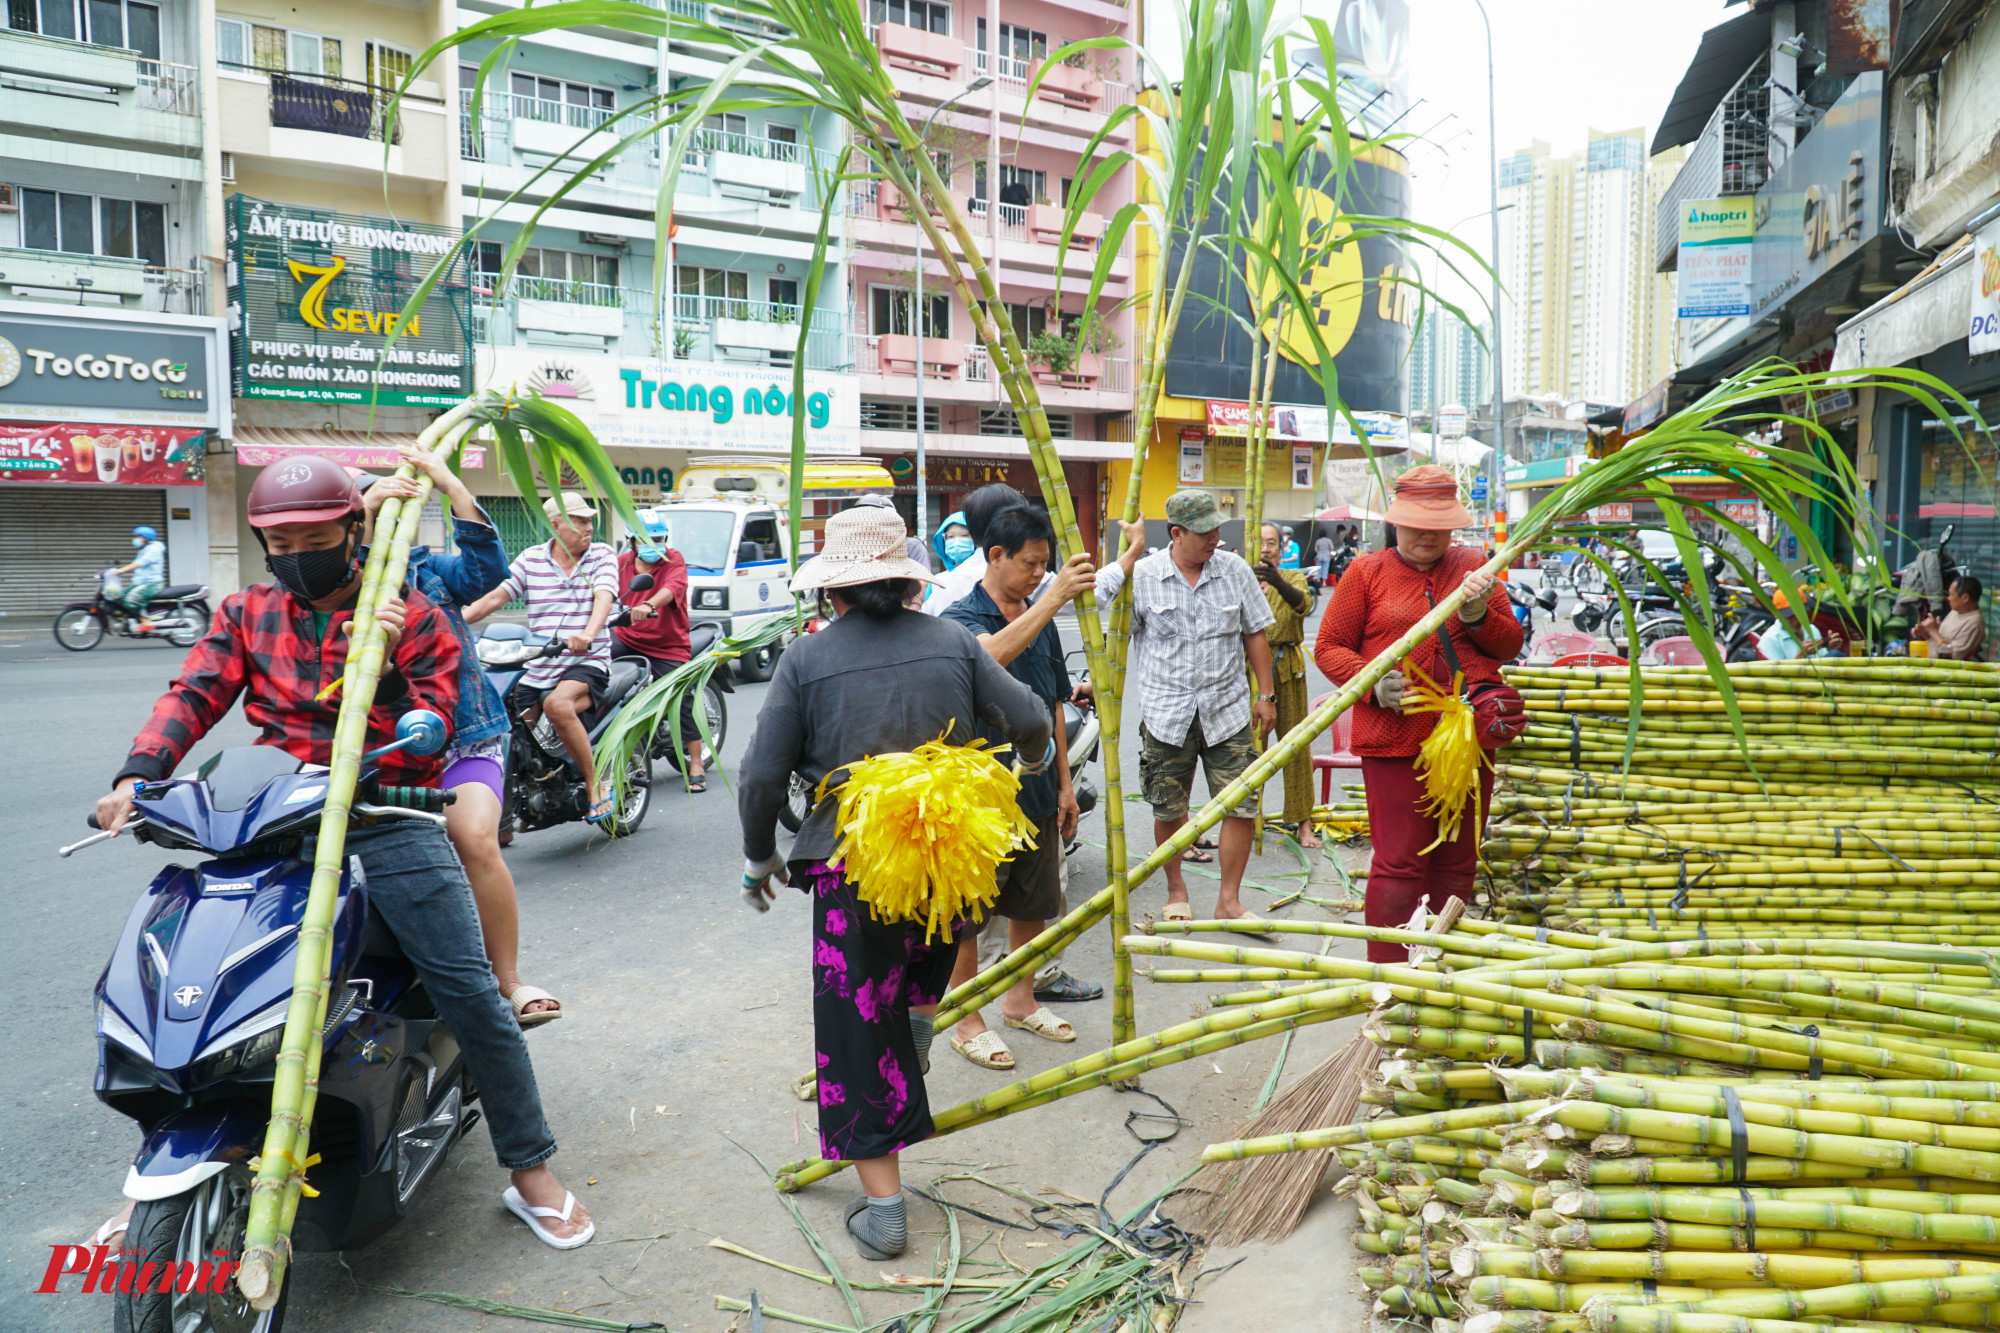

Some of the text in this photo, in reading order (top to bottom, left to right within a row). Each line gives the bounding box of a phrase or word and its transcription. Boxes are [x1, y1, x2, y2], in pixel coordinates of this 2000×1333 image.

[248, 203, 282, 237] ẨM
[286, 217, 346, 248] THỰC
[1701, 209, 1747, 223] hoptri
[1716, 251, 1749, 267] PHÁT
[287, 255, 420, 337] 7 SEVEN
[1971, 313, 1998, 337] ĐC:
[251, 340, 300, 360] PHỤC
[303, 344, 328, 363] VỤ
[331, 340, 375, 362] ĐIỂM
[416, 348, 460, 367] SÁNG
[248, 360, 461, 388] CÁC MÓN XÀO HONGKONG
[545, 368, 575, 381] TKC
[687, 367, 702, 375] TY
[160, 387, 187, 398] Tea
[261, 387, 285, 397] Quang
[335, 391, 361, 400] TPHCM
[619, 367, 734, 424] Trang
[615, 466, 674, 493] ang
[204, 882, 254, 893] HONDA
